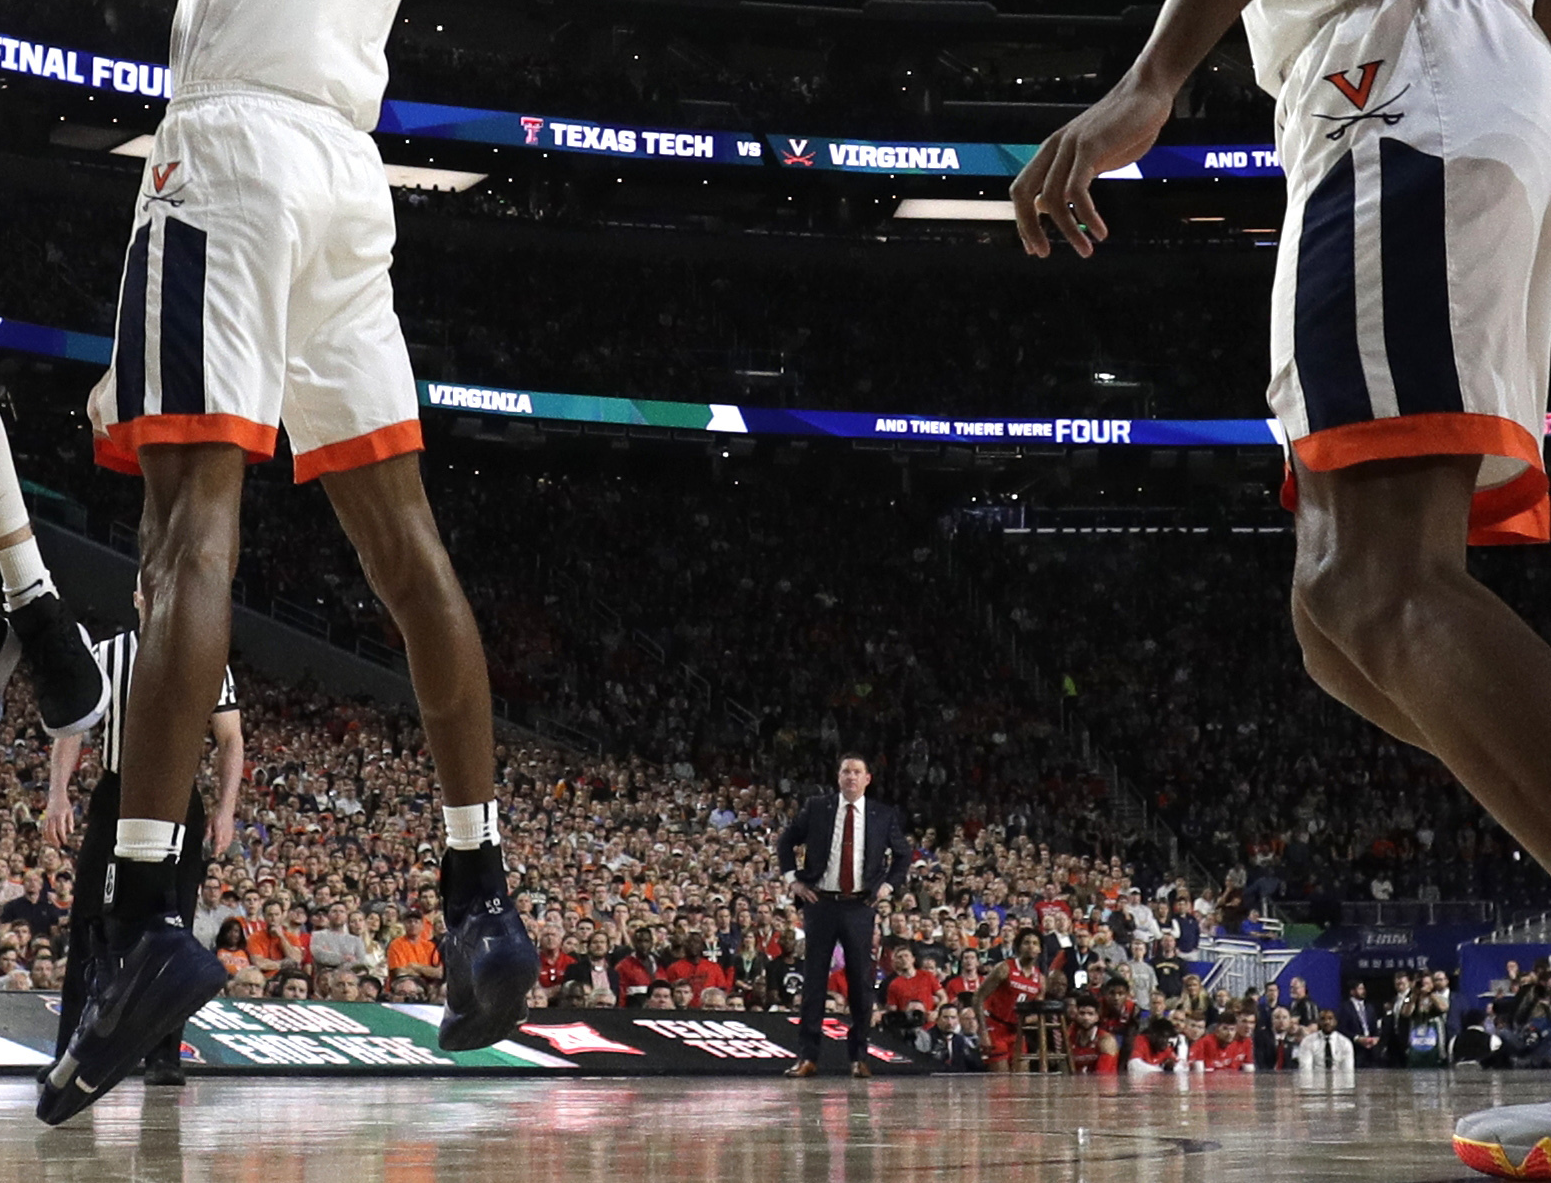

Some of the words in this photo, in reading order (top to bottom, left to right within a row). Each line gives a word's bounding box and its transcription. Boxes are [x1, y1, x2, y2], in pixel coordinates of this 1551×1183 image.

[549, 122, 637, 153] TEXAS
[641, 130, 713, 158] TECH
[828, 143, 960, 169] VIRGINIA
[1204, 151, 1248, 169] AND
[428, 384, 533, 414] VIRGINIA
[875, 418, 908, 433] AND
[910, 419, 952, 435] THEN
[954, 421, 1004, 437] THERE
[1007, 422, 1052, 438] WERE
[1055, 418, 1132, 444] FOUR
[232, 1001, 371, 1035] ROAD
[632, 1018, 767, 1040] TEXAS
[209, 1034, 351, 1065] ENDS
[320, 1035, 456, 1065] HERE
[683, 1039, 799, 1059] TECH
